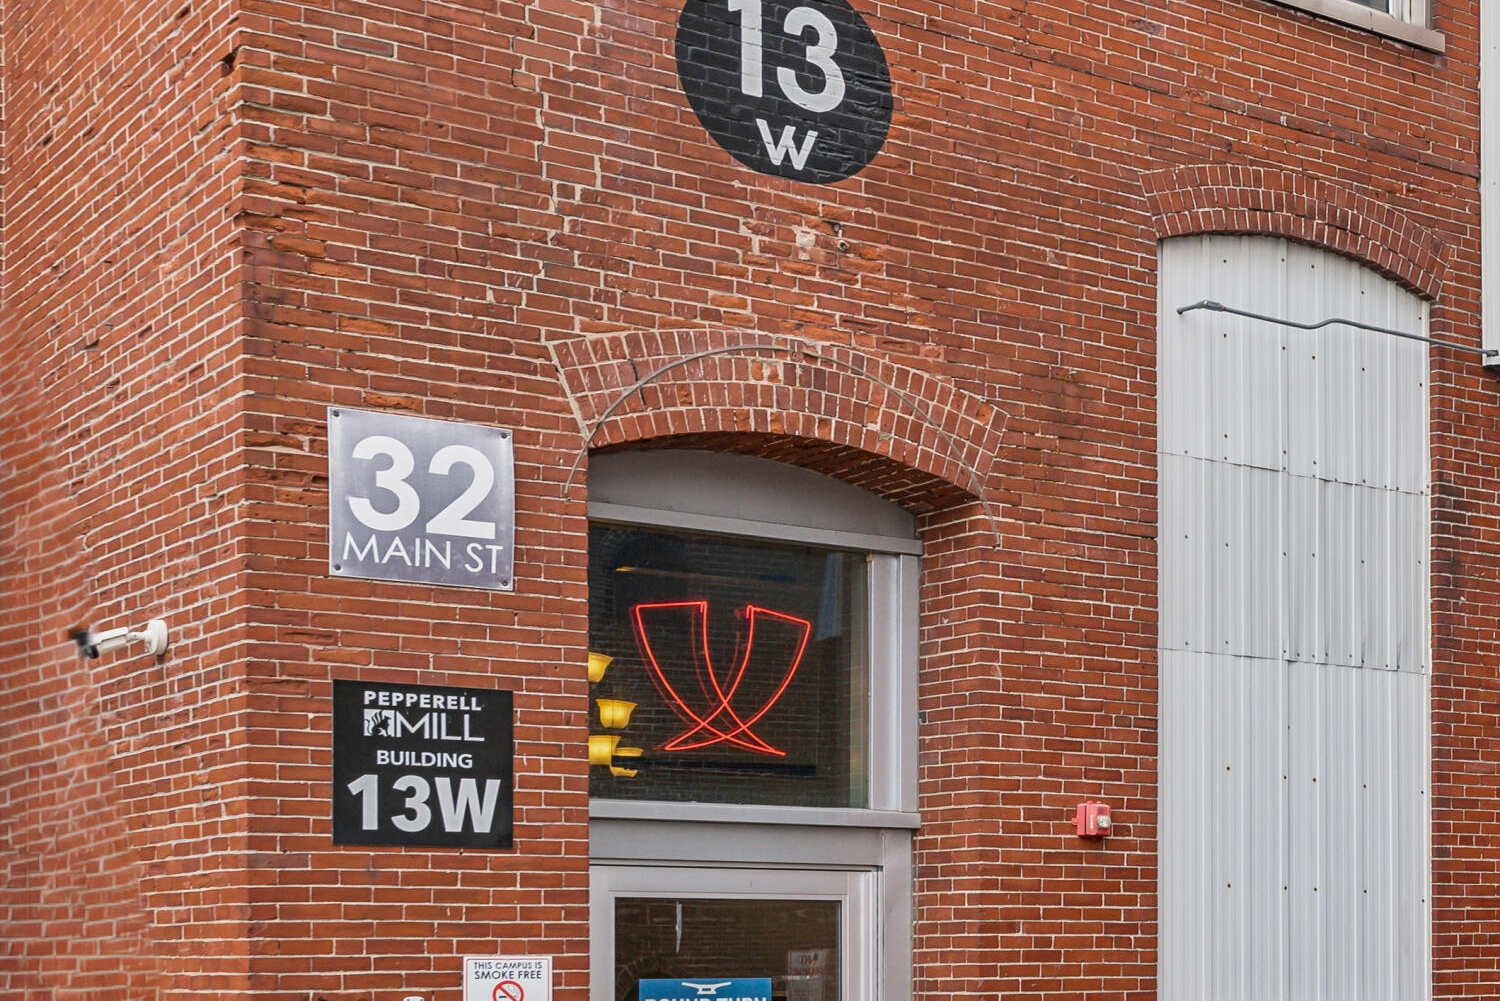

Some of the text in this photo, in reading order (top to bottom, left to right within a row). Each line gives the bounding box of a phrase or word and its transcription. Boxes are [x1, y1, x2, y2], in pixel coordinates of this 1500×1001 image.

[755, 117, 819, 171] W
[348, 434, 497, 540] 32
[342, 530, 504, 575] MAIN ST
[362, 690, 483, 712] PEPPERELL
[395, 709, 486, 742] MILL
[376, 749, 474, 769] BUILDING
[346, 773, 502, 834] 13W
[473, 961, 544, 970] THIS CAMPUS IS
[474, 970, 543, 980] SMOKE FREE
